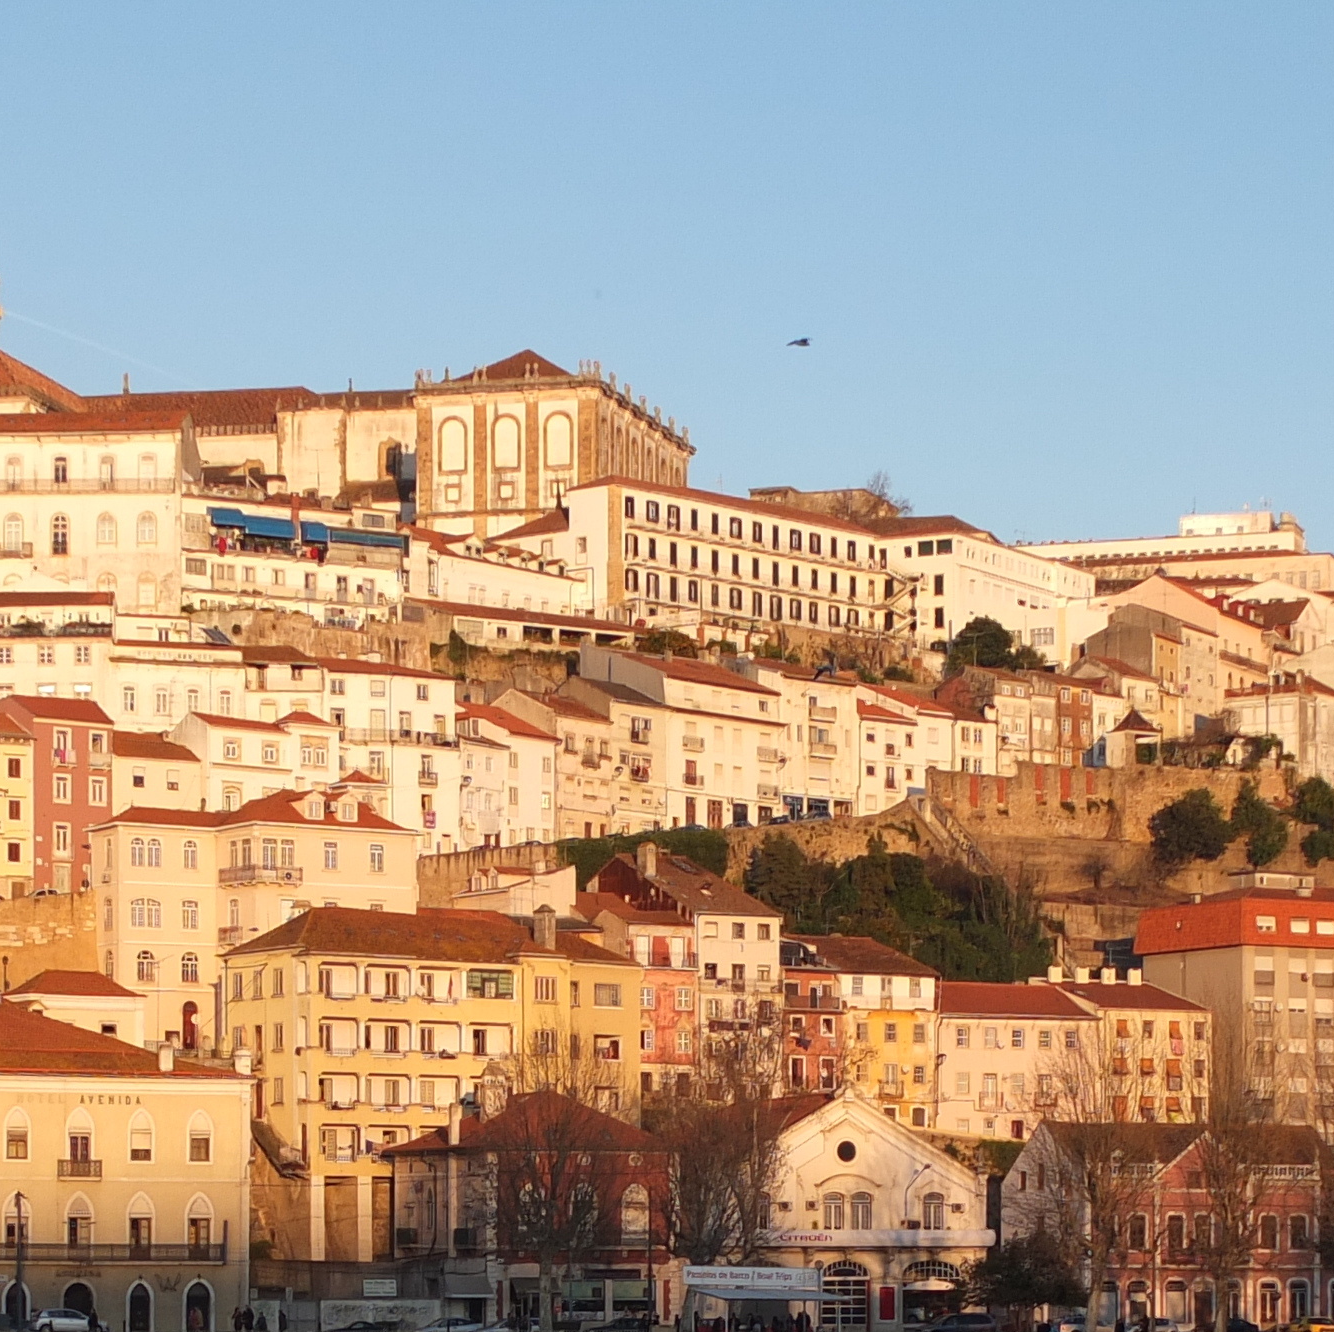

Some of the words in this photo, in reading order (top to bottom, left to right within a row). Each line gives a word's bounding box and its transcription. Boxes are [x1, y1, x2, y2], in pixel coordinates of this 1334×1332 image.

[16, 1093, 66, 1104] HOTEL
[79, 1094, 142, 1105] AVENIDA
[757, 1271, 774, 1281] Boat
[775, 1271, 793, 1282] Trips
